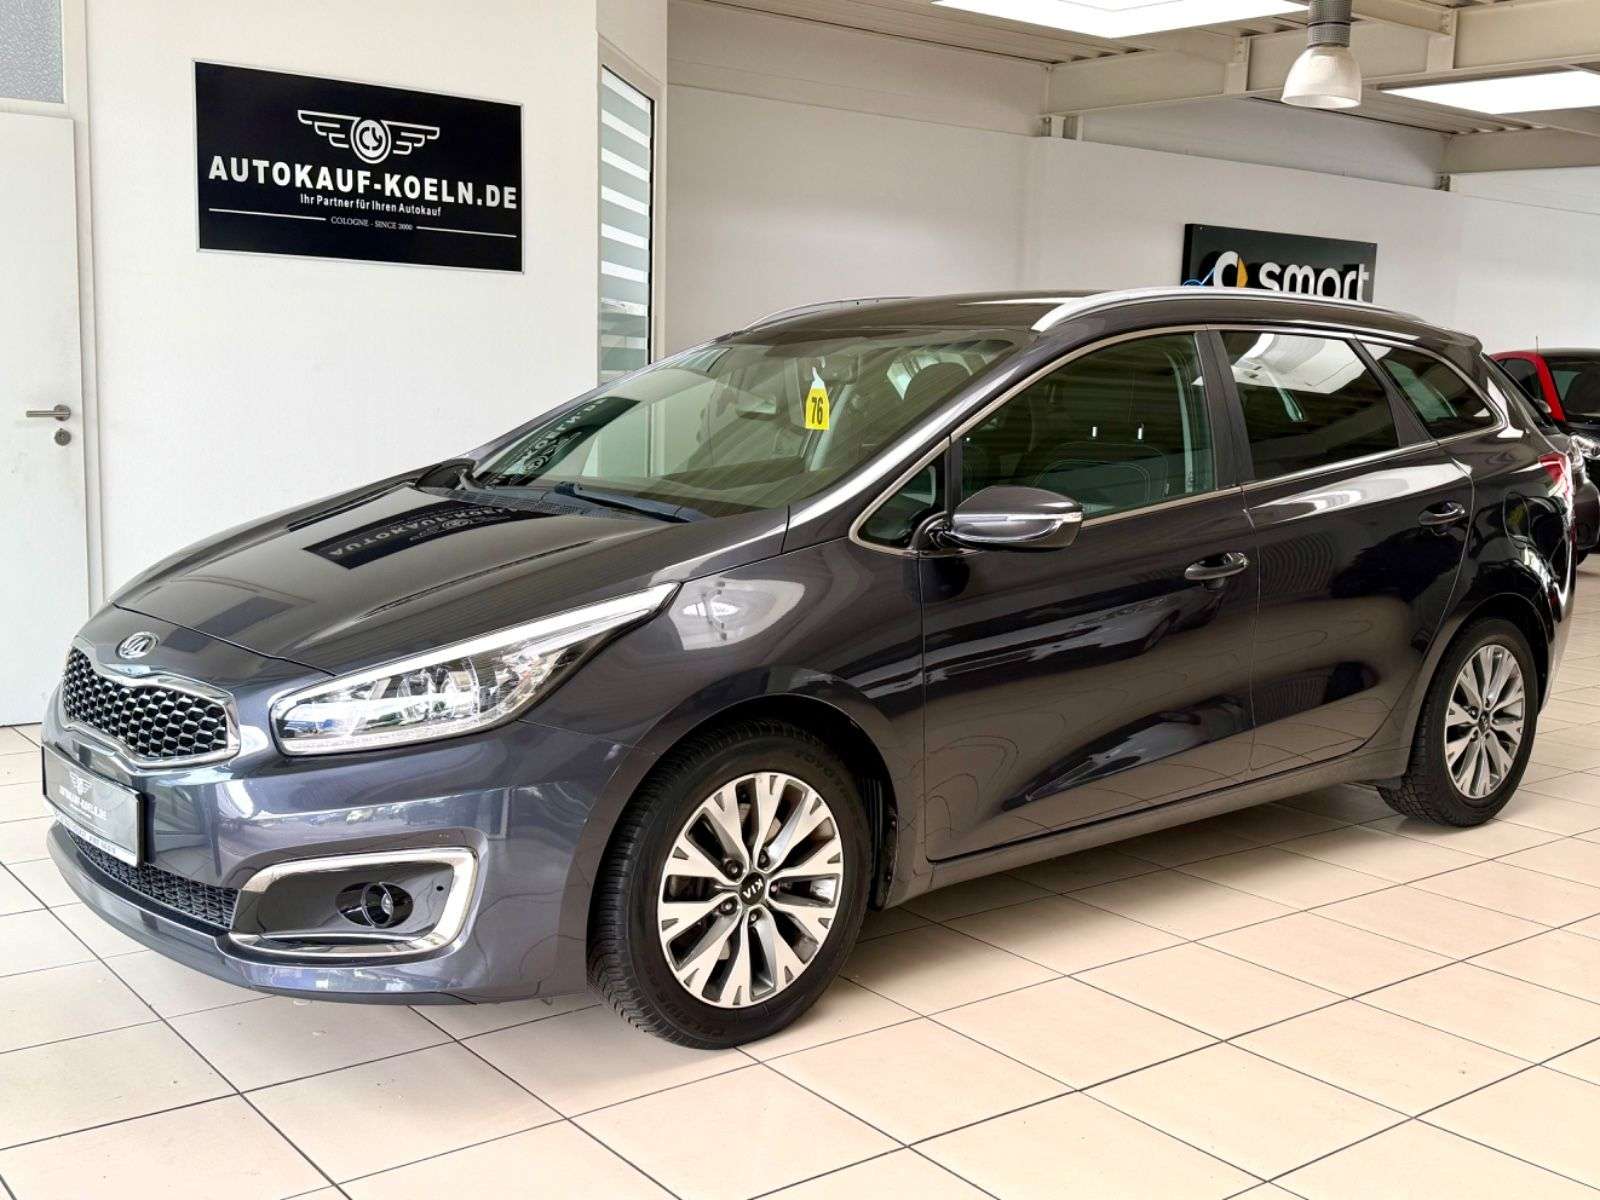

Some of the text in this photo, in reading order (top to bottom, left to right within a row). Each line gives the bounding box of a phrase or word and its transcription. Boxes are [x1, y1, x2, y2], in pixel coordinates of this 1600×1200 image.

[208, 155, 517, 209] AUTOKAUF-KOELN.DE
[300, 193, 441, 217] Ihr Partner für Ihren Autokauf
[330, 216, 369, 227] COLOGNE
[374, 220, 397, 230] SINCE
[811, 396, 824, 425] 76
[743, 878, 764, 899] KIA
